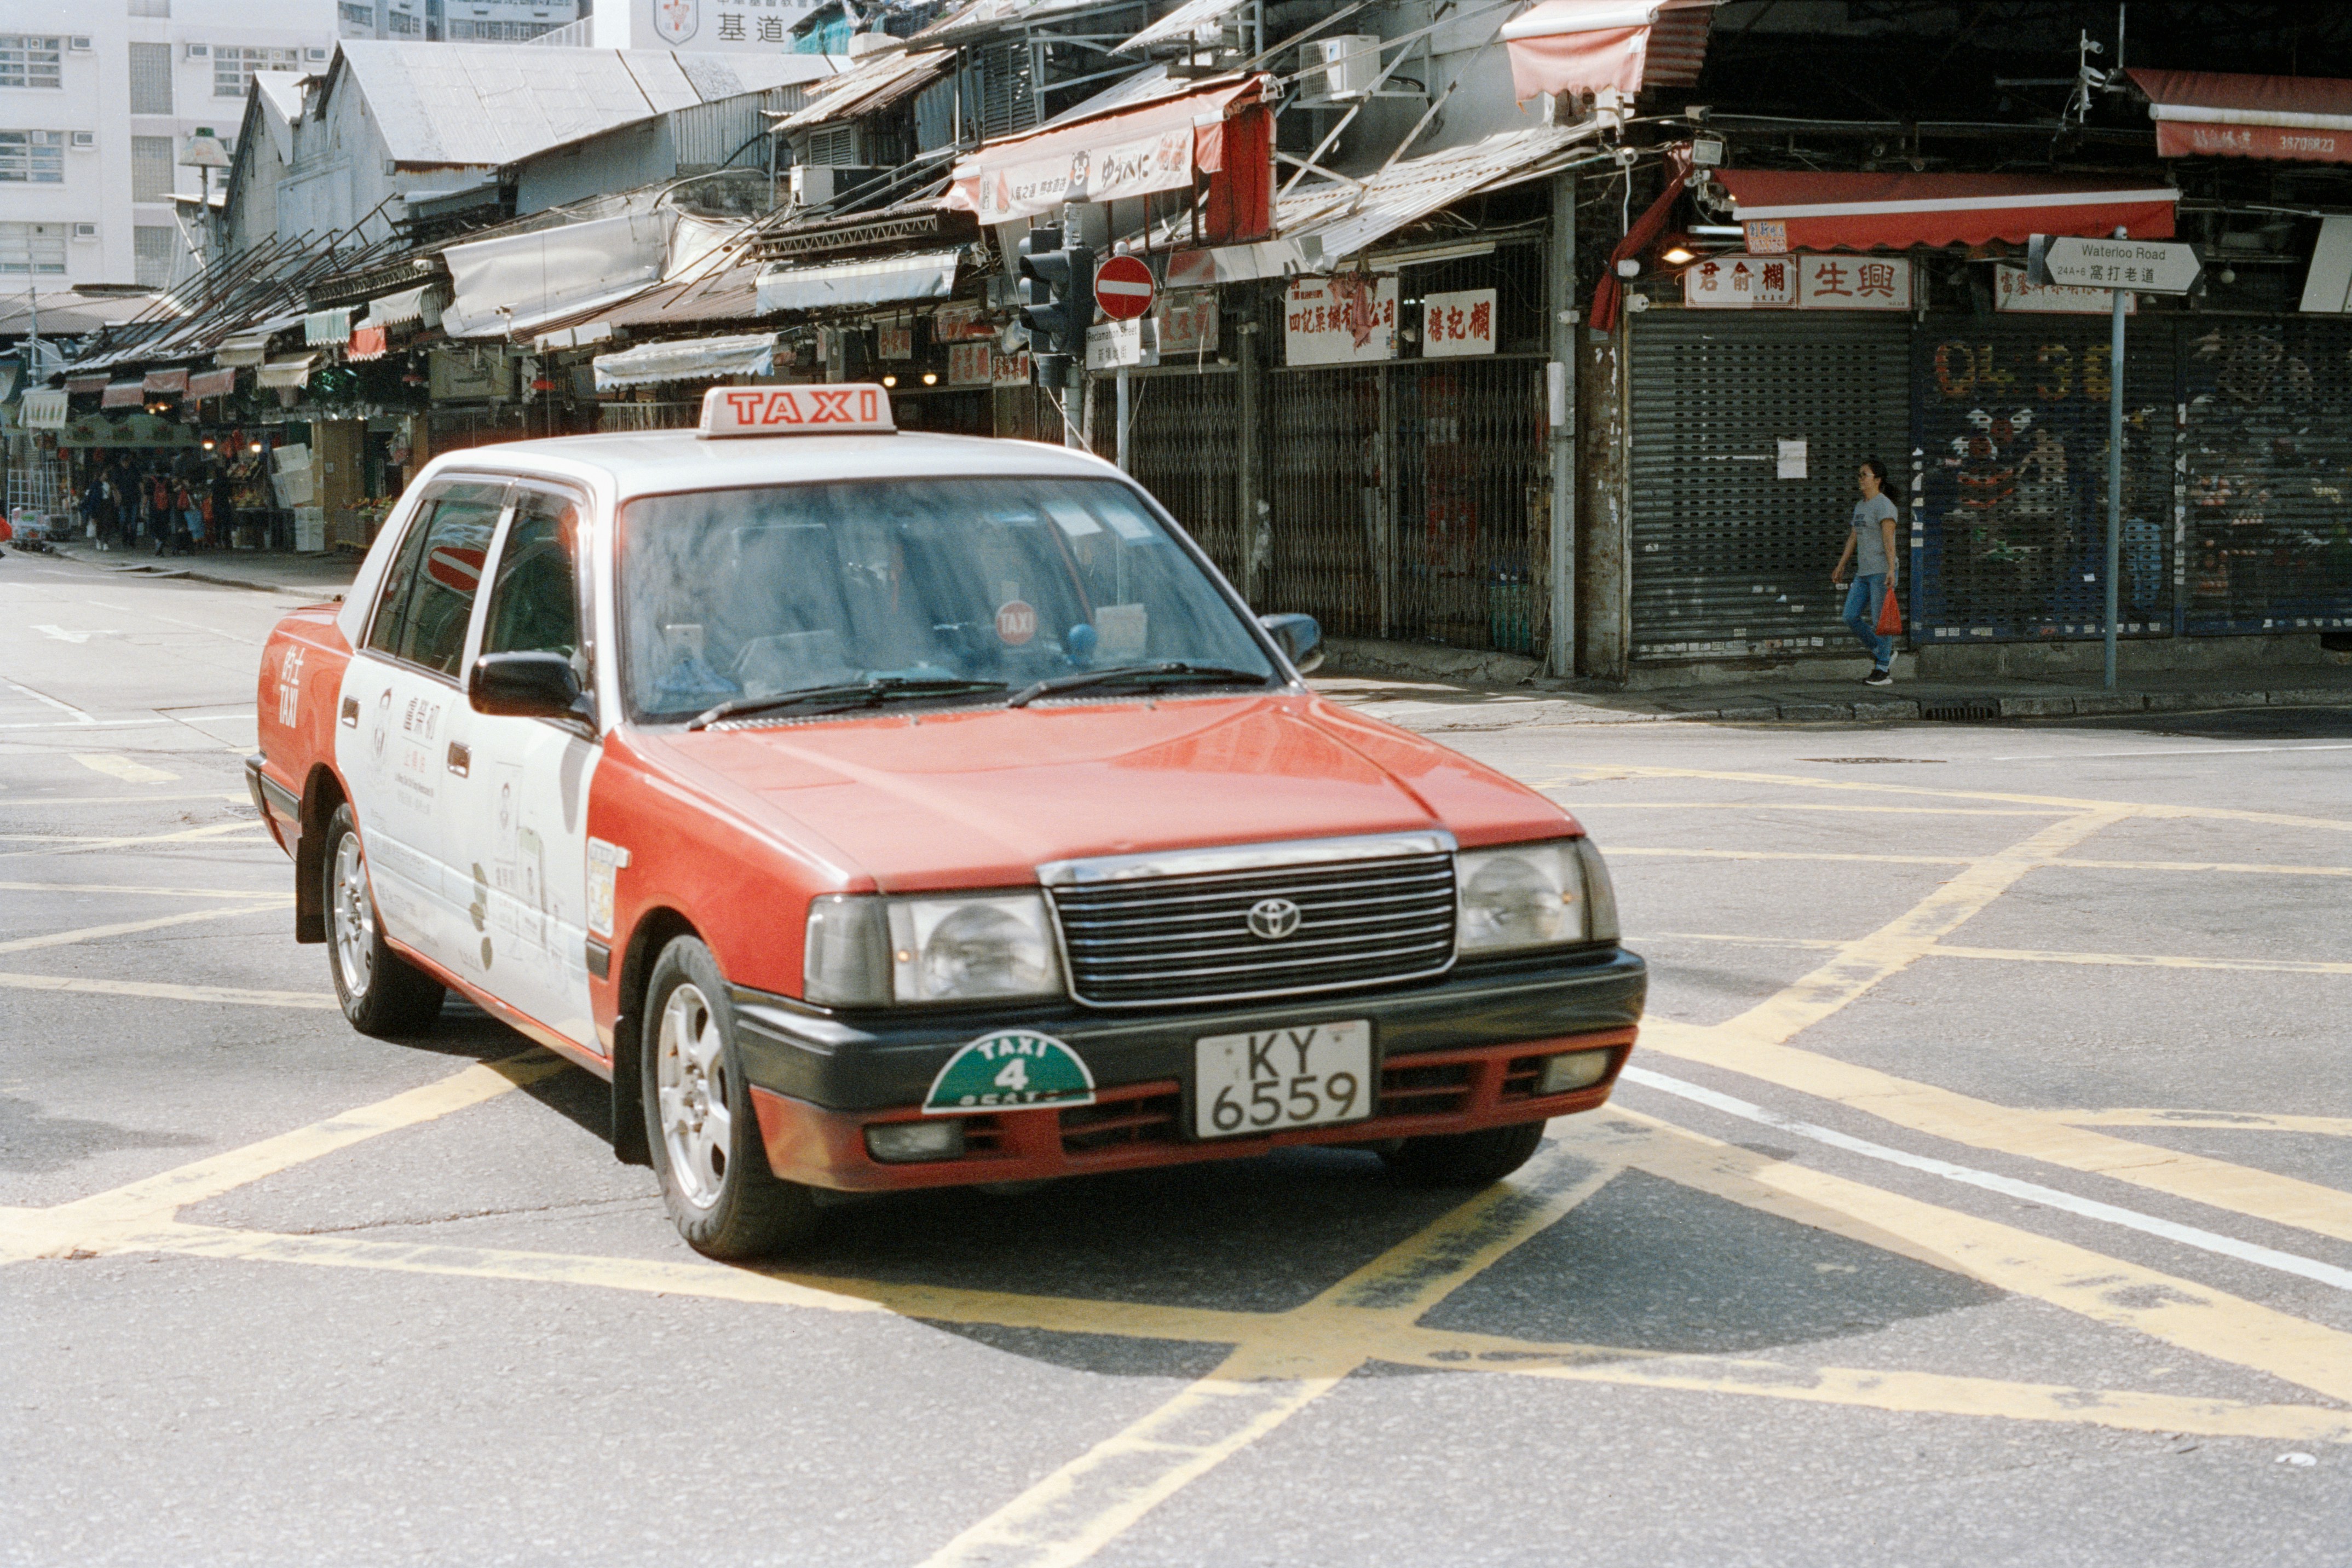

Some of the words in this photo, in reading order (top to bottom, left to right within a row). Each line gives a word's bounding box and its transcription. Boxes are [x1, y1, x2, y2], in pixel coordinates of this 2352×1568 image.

[718, 13, 784, 42] 基道
[2083, 244, 2132, 258] Waterloo
[2136, 247, 2166, 261] Road
[1813, 261, 1896, 298] 生興
[2090, 265, 2154, 284] 窩打老道
[1289, 298, 1394, 334] 四記菓欄有公司
[1087, 330, 1119, 343] Reclamation
[1120, 324, 1137, 338] Street
[727, 390, 877, 426] TAXI
[1001, 612, 1034, 634] TAXI
[281, 645, 305, 685] 的士
[280, 684, 298, 728] TAXI
[977, 1037, 1047, 1060] TAXI
[1248, 1027, 1317, 1081] KY
[994, 1058, 1029, 1091] 4
[1212, 1071, 1358, 1131] 6559
